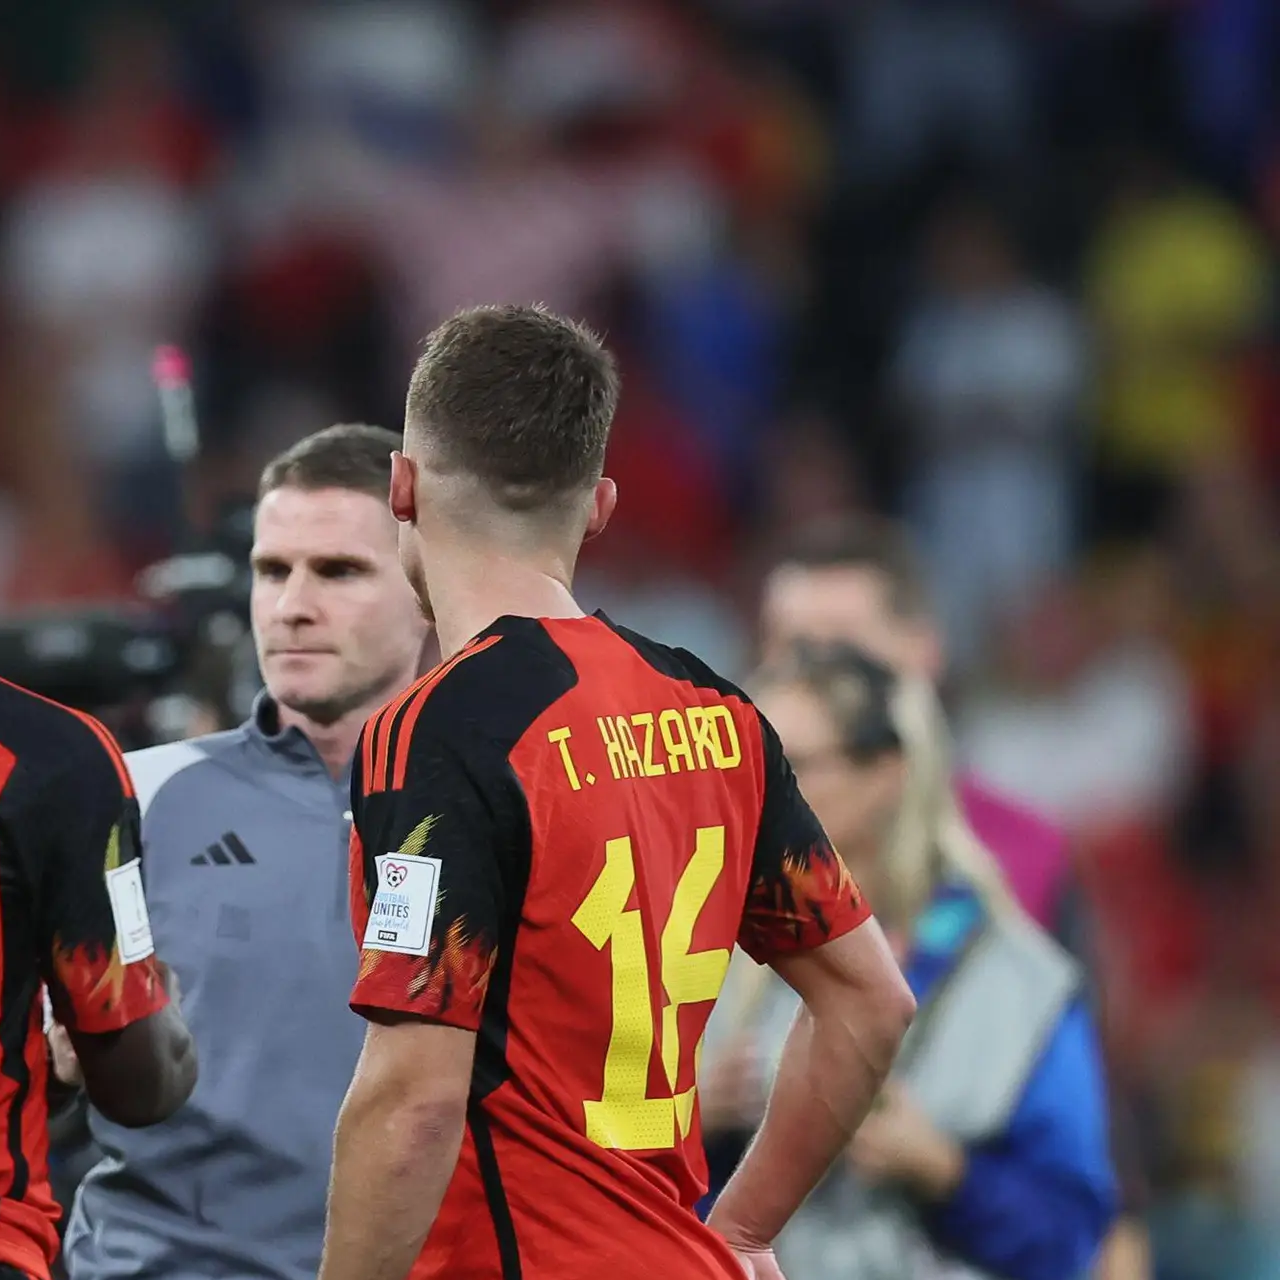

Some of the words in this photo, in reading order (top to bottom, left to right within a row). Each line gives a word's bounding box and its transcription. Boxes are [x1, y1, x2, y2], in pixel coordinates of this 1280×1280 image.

[547, 726, 596, 791] T.
[597, 705, 741, 779] HAZARD
[374, 902, 409, 918] UNITES
[379, 931, 396, 940] FIFA
[570, 826, 731, 1149] 16
